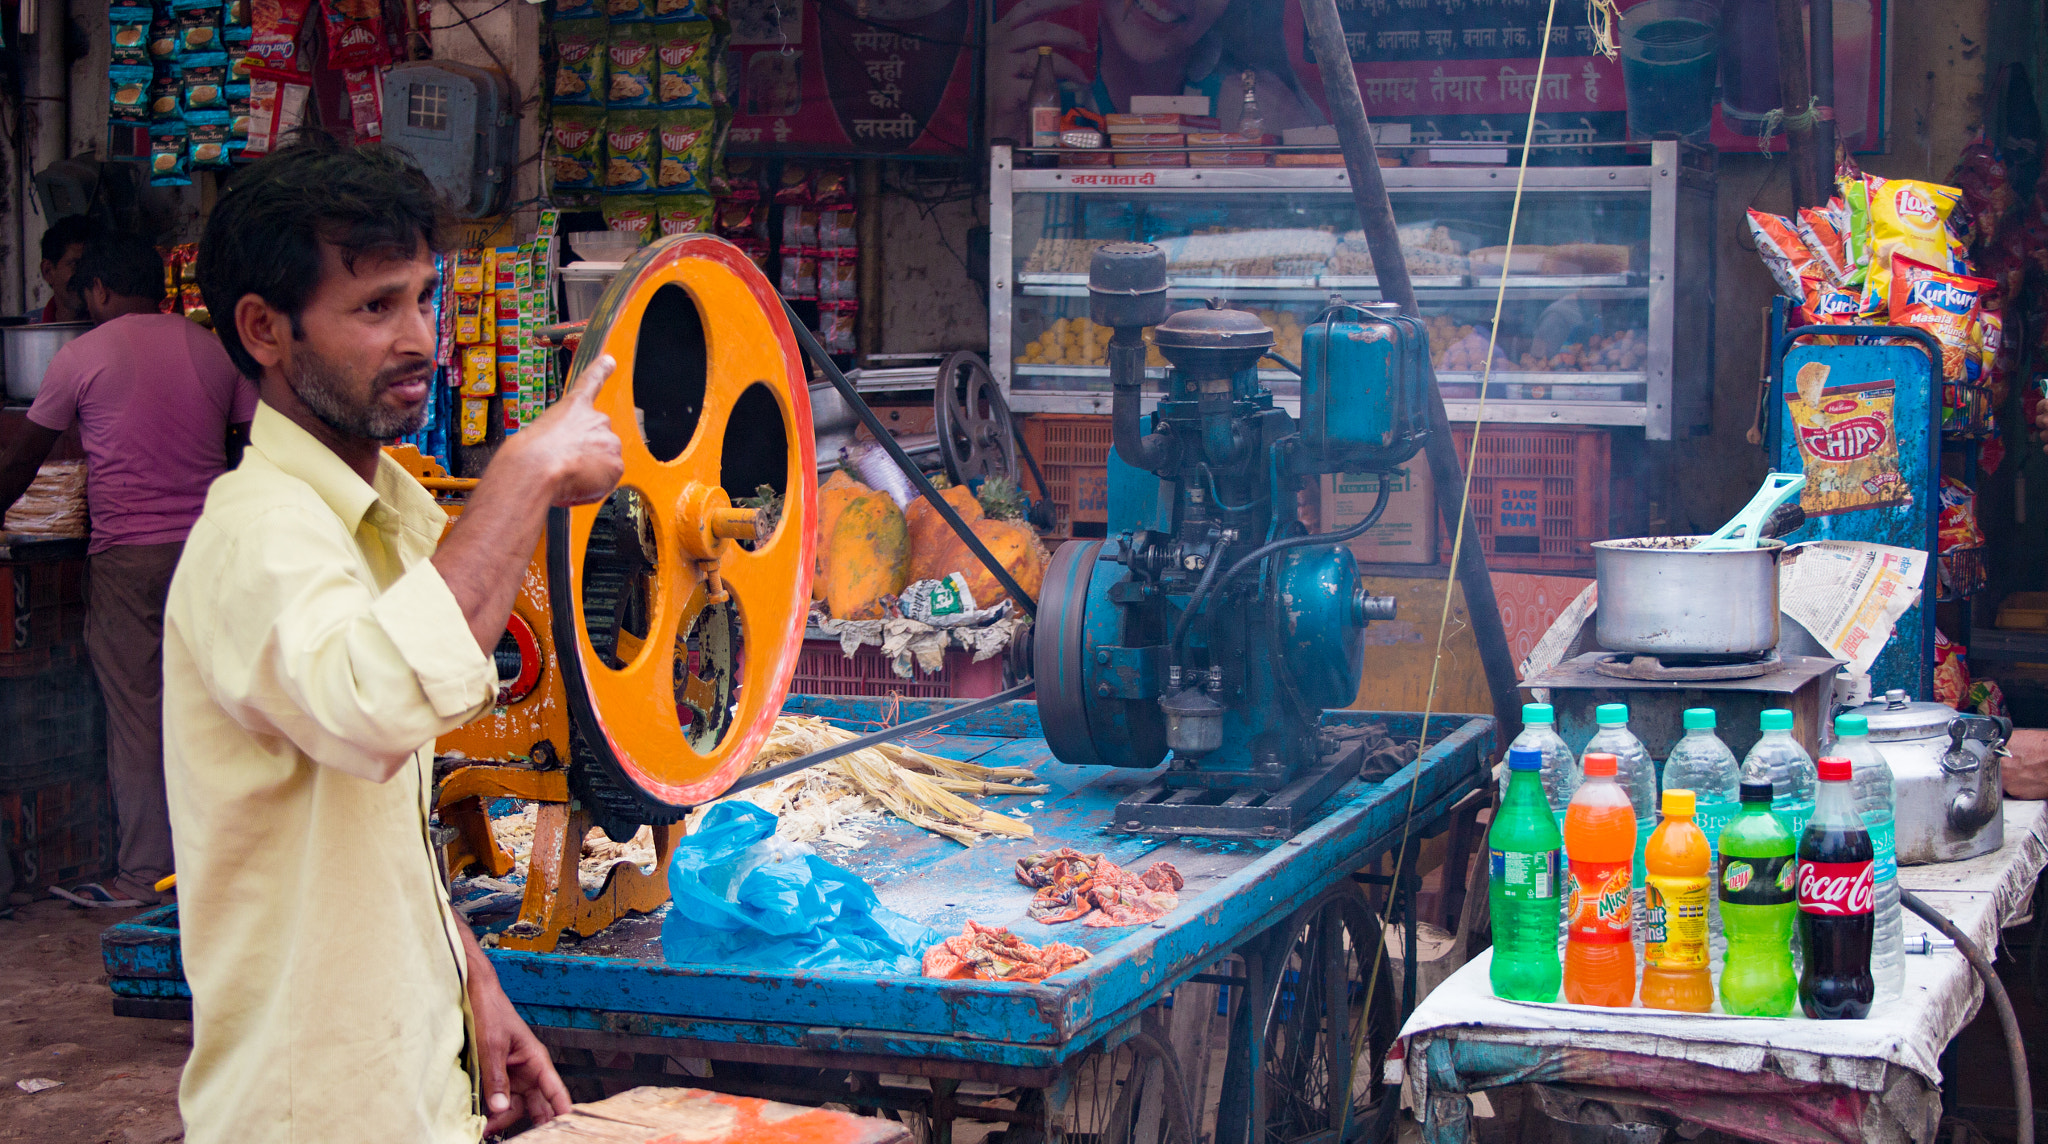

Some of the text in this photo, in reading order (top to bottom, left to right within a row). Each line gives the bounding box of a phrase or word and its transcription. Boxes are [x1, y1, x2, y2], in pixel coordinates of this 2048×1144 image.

[609, 47, 647, 65] CHIPS
[659, 45, 695, 65] CHIPS
[865, 54, 905, 82] दही
[1428, 66, 1487, 103] तैयार
[1582, 61, 1602, 104] है
[852, 112, 917, 138] लस्सी
[555, 130, 590, 149] CHIPS
[609, 132, 644, 151] CHIPS
[661, 134, 695, 152] CHIPS
[1071, 174, 1097, 185] जय
[1138, 172, 1156, 185] दी
[1913, 279, 1978, 310] Kurkure
[1910, 313, 1952, 326] Masala
[1937, 324, 1967, 339] Munch
[1806, 426, 1882, 458] CHIPS
[1500, 501, 1537, 511] HYD
